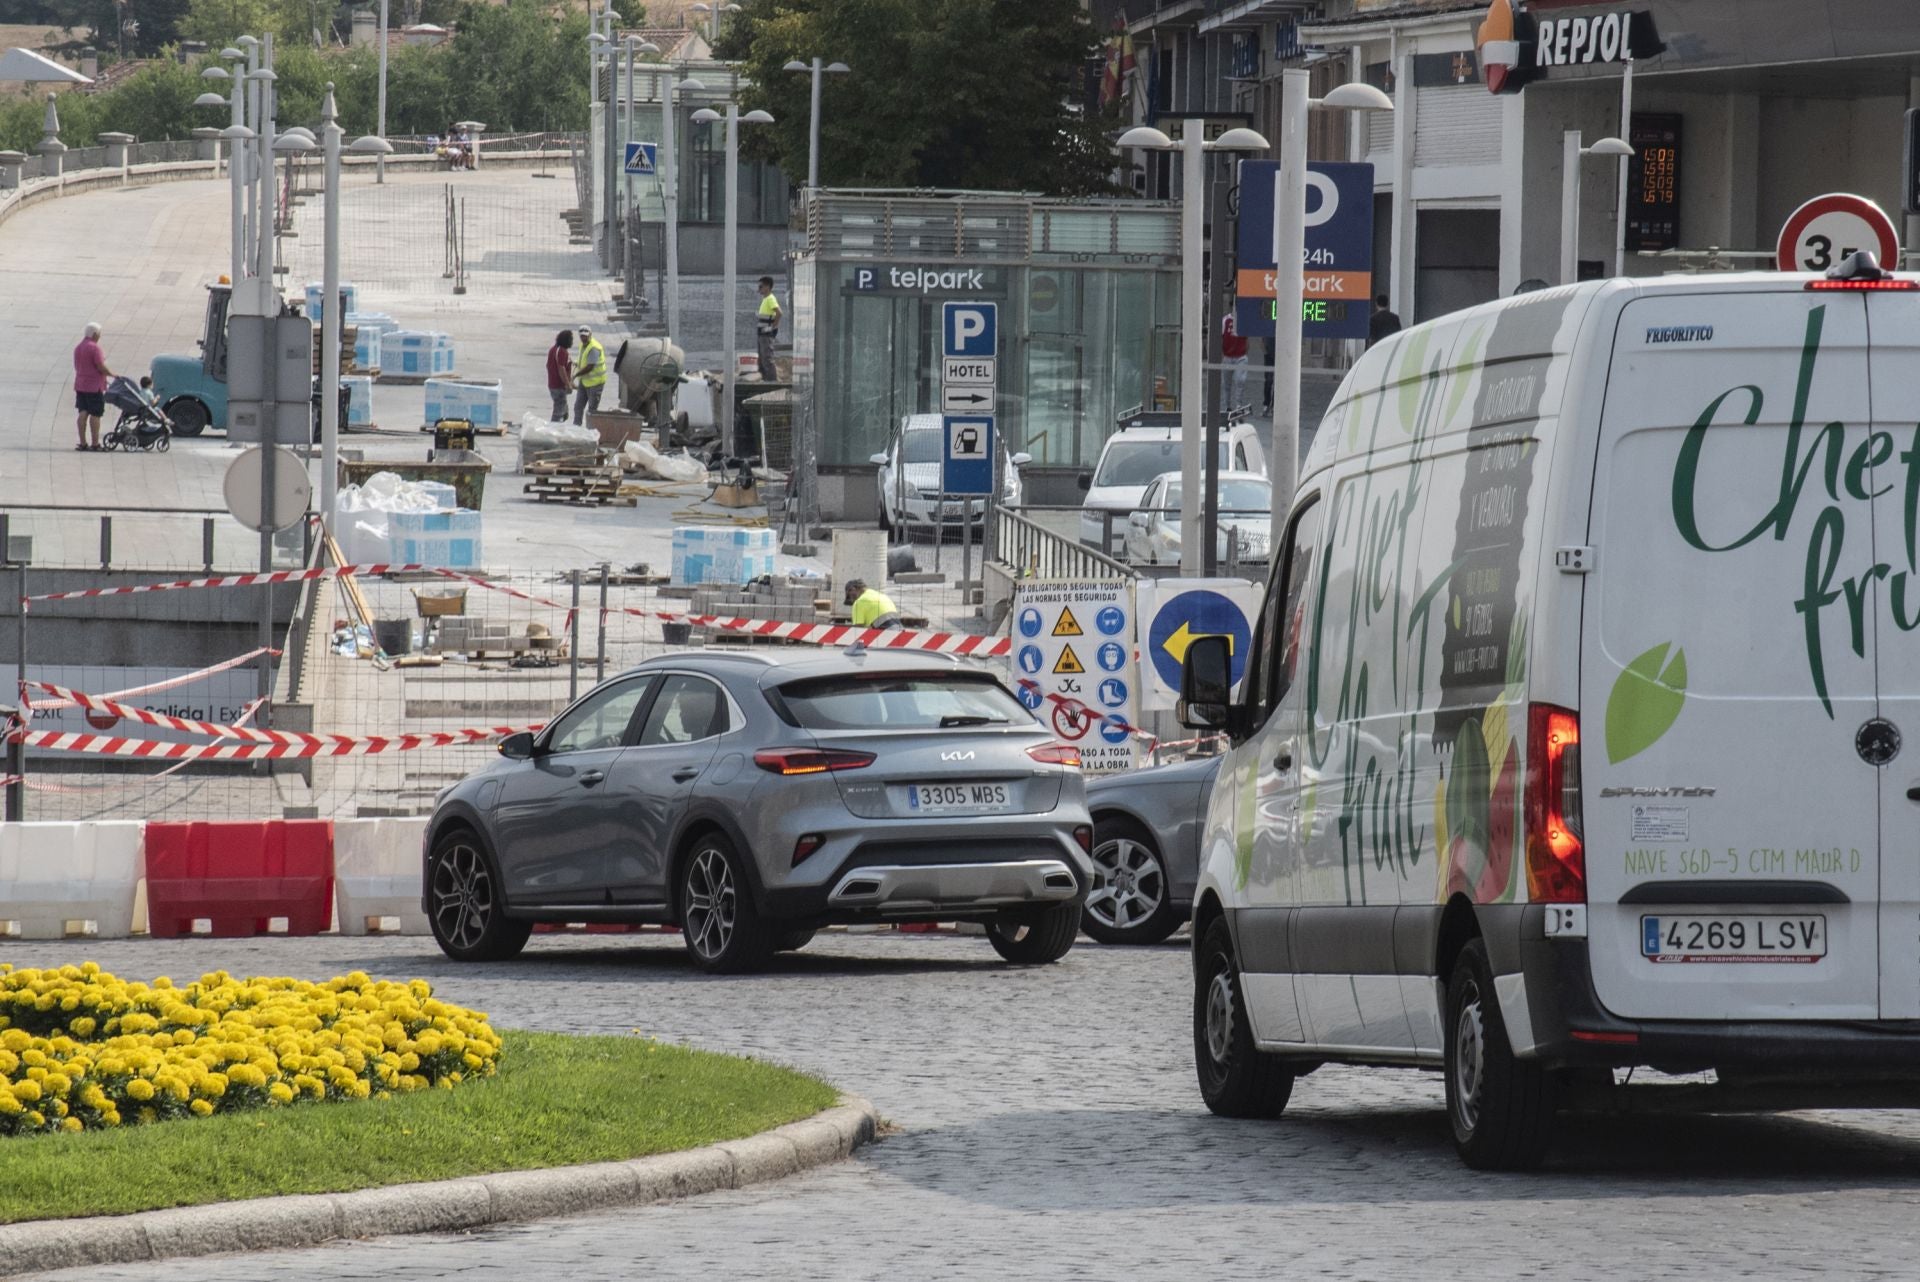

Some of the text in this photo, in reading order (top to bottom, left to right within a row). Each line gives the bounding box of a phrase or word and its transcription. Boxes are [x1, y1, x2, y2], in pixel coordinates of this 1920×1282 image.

[1536, 13, 1632, 66] REPSOL
[1170, 124, 1228, 139] HTE
[890, 267, 984, 294] telpark
[1272, 300, 1326, 321] LRE
[954, 310, 985, 350] P
[1646, 325, 1713, 343] FRIGORIFICO
[950, 365, 990, 377] HOTEL
[1028, 583, 1068, 593] OBLIGATORIO
[1070, 582, 1097, 591] SEGUIR
[1099, 582, 1123, 590] TODAS
[1022, 592, 1117, 603] LAS NORMAS DE SEGURIDAD
[941, 751, 976, 761] KIA
[1080, 748, 1097, 757] ASO
[1109, 748, 1131, 756] TODA
[1094, 761, 1105, 769] LA
[1107, 760, 1129, 769] OBRA
[920, 787, 966, 805] 3305
[972, 786, 1005, 804] MBS
[1599, 786, 1717, 799] SPRINTER
[1624, 850, 1667, 874] NAVE
[1750, 849, 1784, 873] CTM
[1666, 921, 1746, 949] 4269
[1757, 921, 1816, 949] LSV
